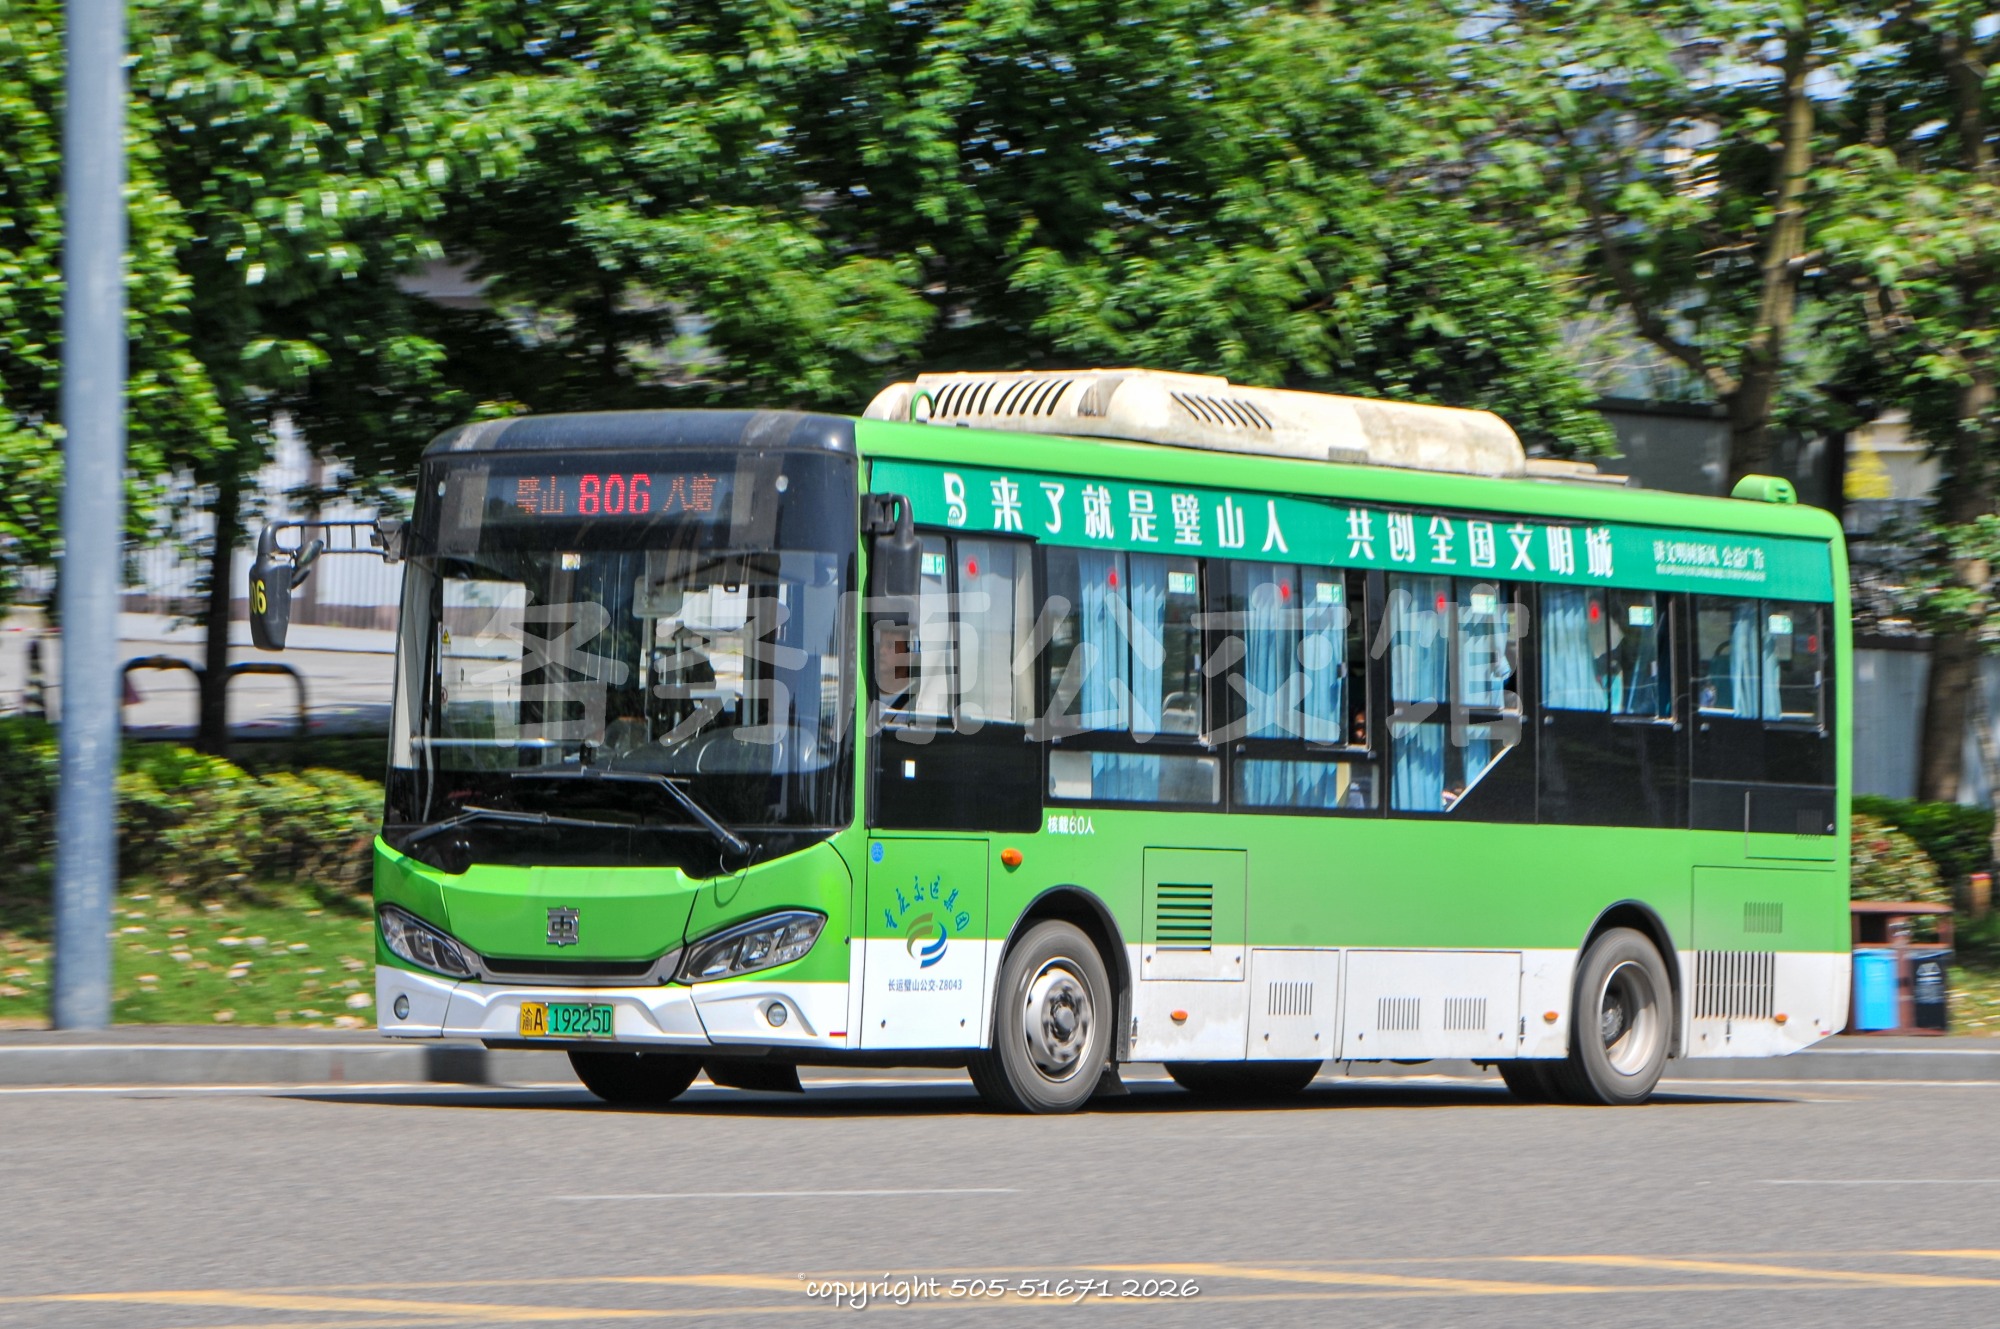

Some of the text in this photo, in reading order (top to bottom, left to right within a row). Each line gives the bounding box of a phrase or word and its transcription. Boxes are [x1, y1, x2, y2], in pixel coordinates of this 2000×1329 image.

[578, 473, 651, 515] 806
[662, 472, 717, 512] 八塘
[990, 476, 1614, 579] 来了就是璧山人 共创全国文明城
